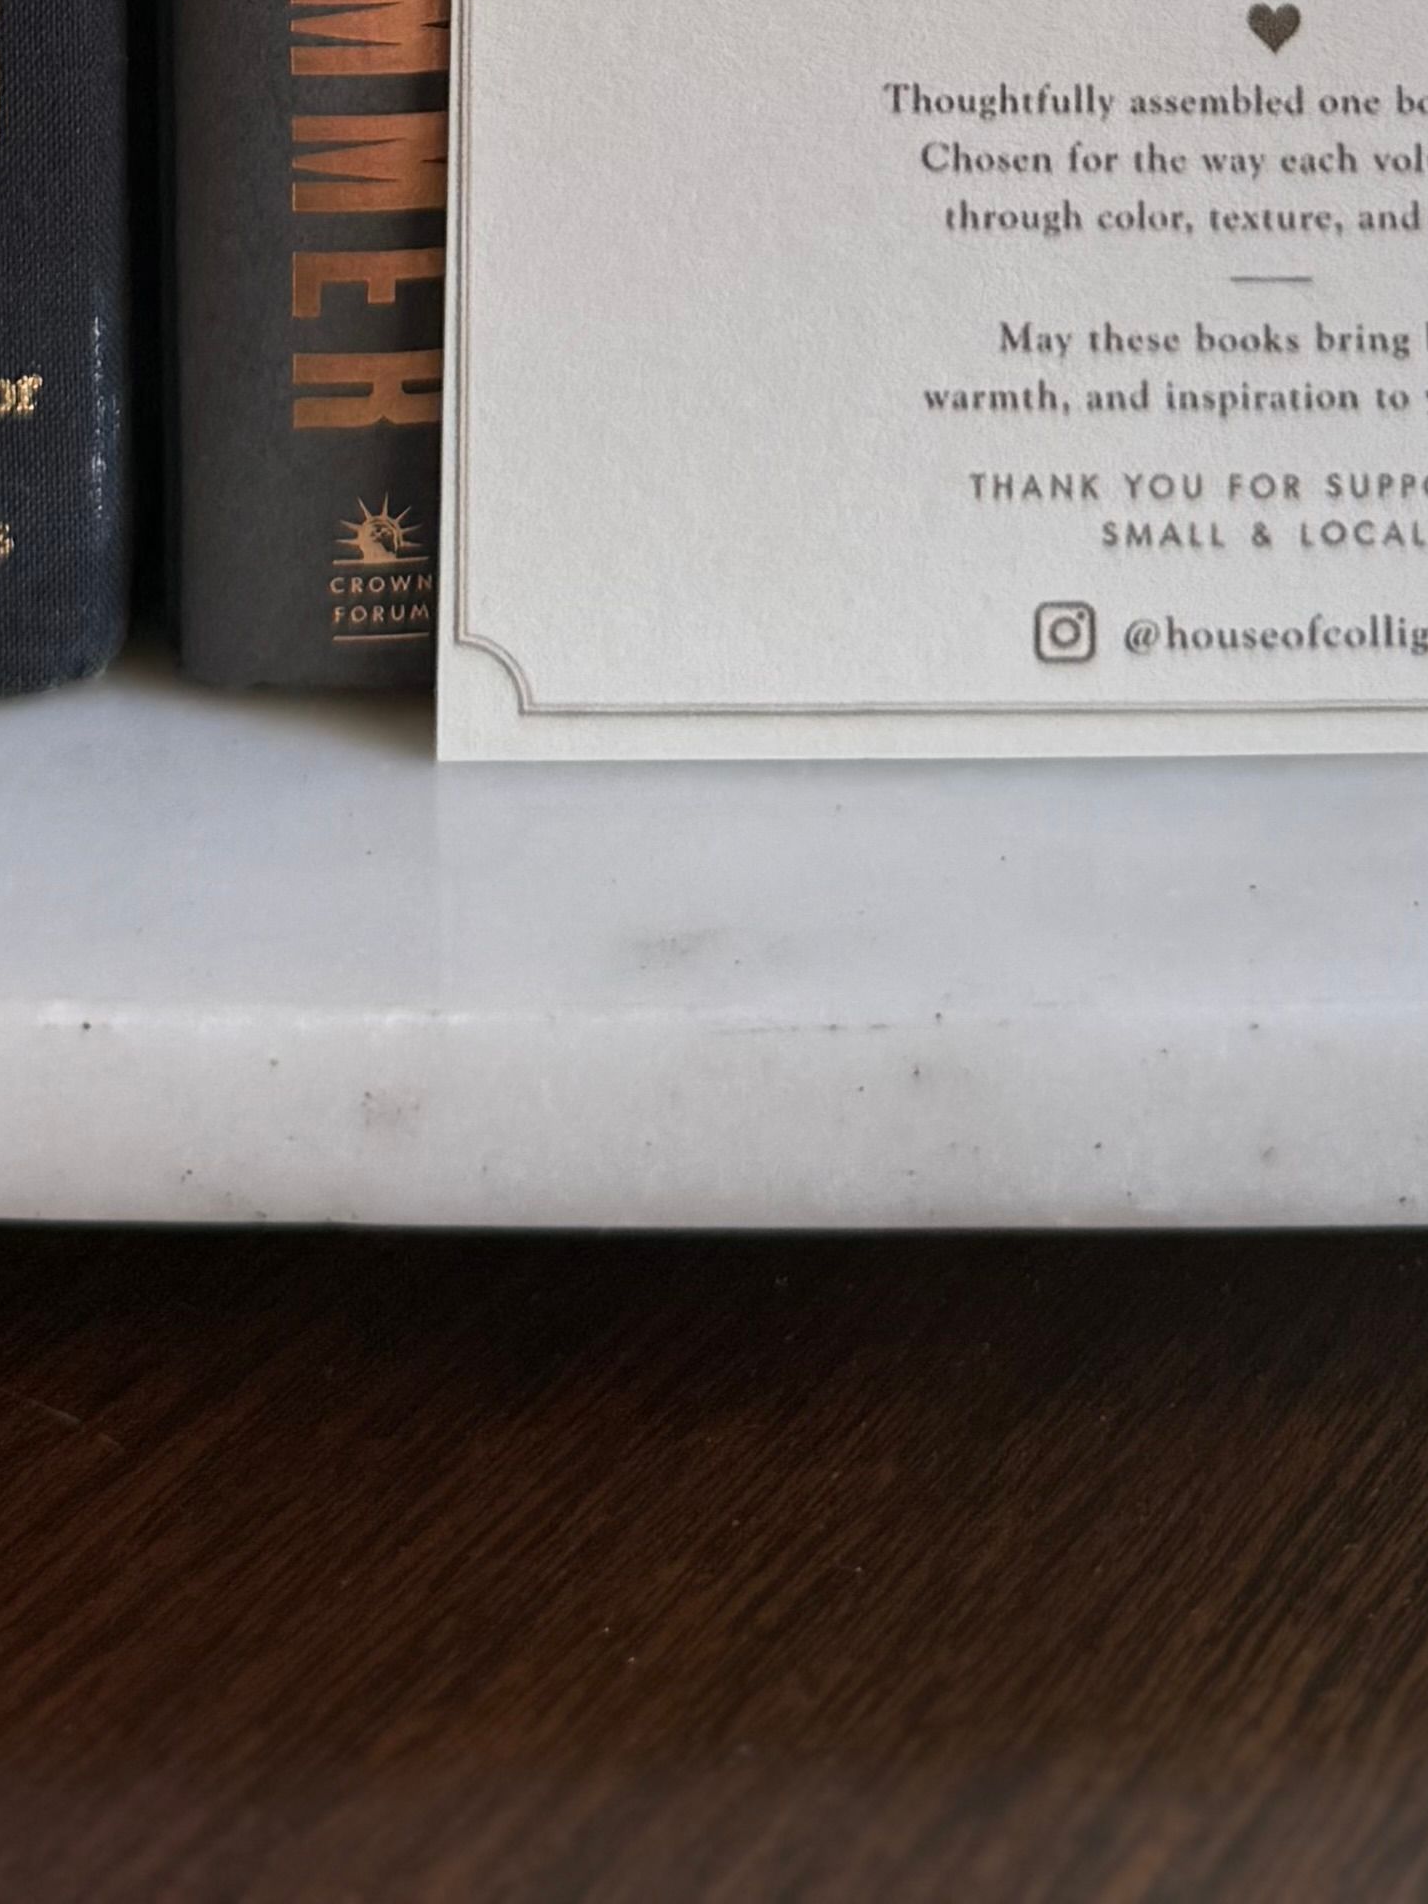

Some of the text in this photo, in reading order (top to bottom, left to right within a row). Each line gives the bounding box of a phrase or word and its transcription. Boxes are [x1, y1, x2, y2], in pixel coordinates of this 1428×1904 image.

[881, 81, 1116, 125] Thoughtfully
[1129, 83, 1305, 118] assembled
[1317, 94, 1381, 117] one
[919, 140, 1053, 176] Chosen
[1067, 139, 1119, 175] for
[1133, 140, 1188, 176] the
[1200, 153, 1266, 183] way
[1279, 140, 1359, 177] each
[945, 198, 1084, 240] through
[1096, 198, 1195, 237] color,
[1209, 205, 1344, 238] texture,
[1357, 199, 1423, 233] and
[998, 320, 1073, 361] May
[1088, 320, 1181, 356] these
[1195, 320, 1301, 355] books
[1314, 320, 1411, 362] bring
[923, 378, 1071, 418] warmth,
[1086, 378, 1150, 414] and
[1165, 379, 1360, 422] inspiration
[1375, 386, 1411, 413] to
[968, 471, 1101, 503] THANK
[1123, 471, 1205, 503] YOU
[1227, 472, 1303, 503] FOR
[1101, 519, 1227, 552] SMALL
[1250, 519, 1274, 551] &
[329, 573, 433, 595] CROWN
[332, 603, 430, 625] FORUM
